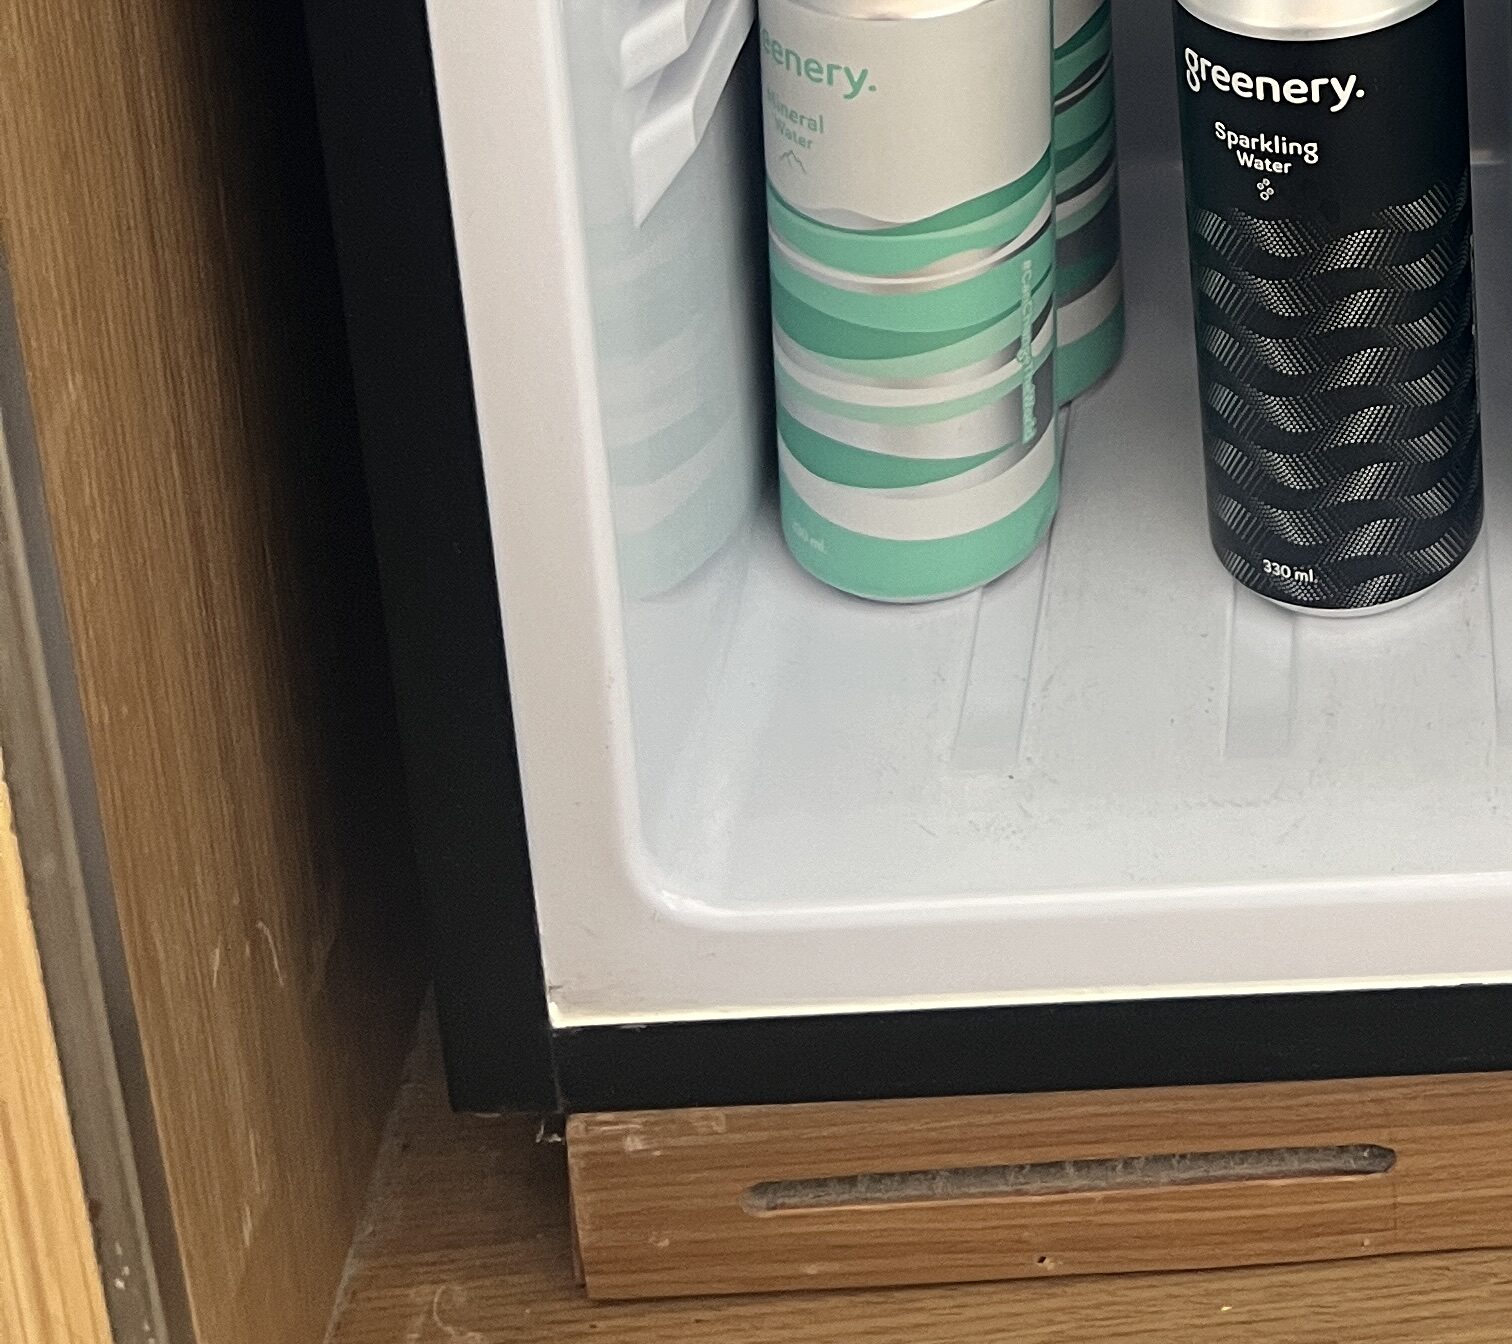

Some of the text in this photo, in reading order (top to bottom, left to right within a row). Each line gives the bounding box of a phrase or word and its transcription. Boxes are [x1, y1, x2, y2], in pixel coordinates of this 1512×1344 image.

[1184, 47, 1366, 113] greenery.
[1214, 121, 1319, 164] Sparkling
[1236, 150, 1293, 174] Water
[1262, 558, 1315, 583] 330 ml
